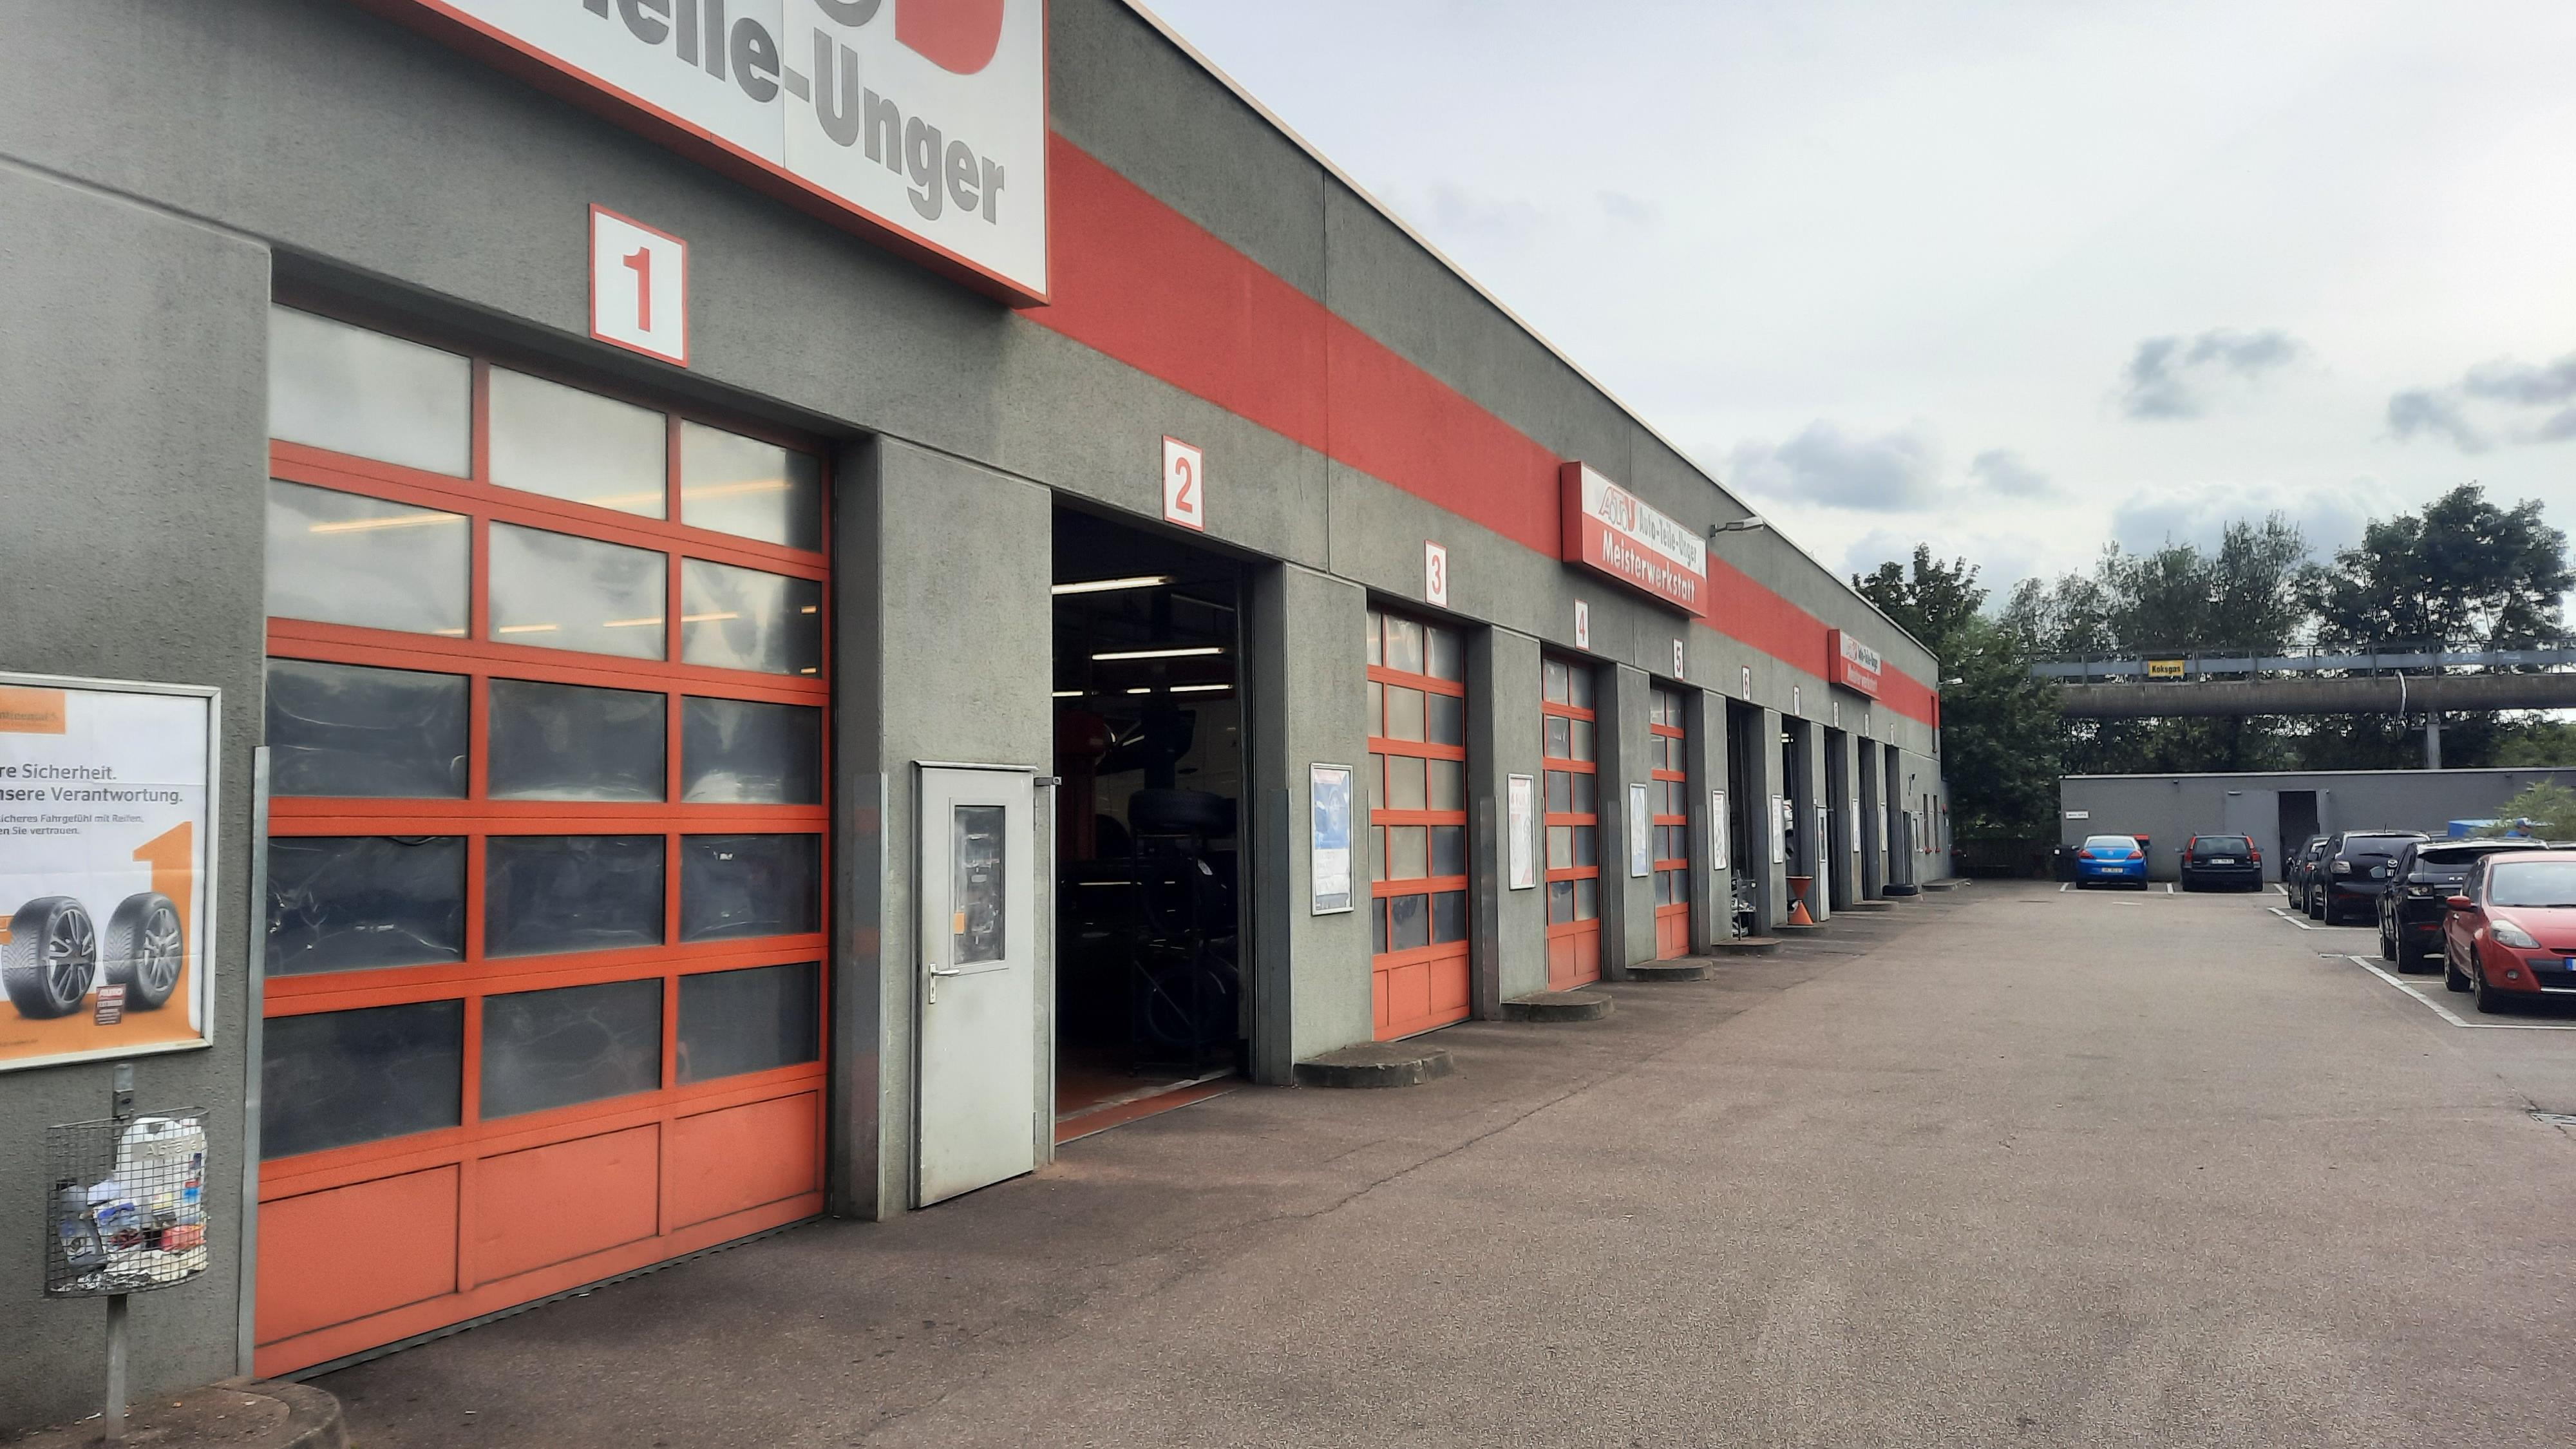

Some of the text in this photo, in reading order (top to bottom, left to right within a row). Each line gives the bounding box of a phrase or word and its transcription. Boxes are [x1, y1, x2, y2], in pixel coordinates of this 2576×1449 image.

[623, 246, 650, 332] 1
[1175, 457, 1193, 514] 2
[1639, 506, 1697, 567] Auto-Teile-Unger
[1432, 554, 1442, 595] 3
[1602, 529, 1696, 603] Meisterwerkstatt
[1579, 610, 1586, 641] 4
[1676, 646, 1681, 673] 5
[2152, 665, 2181, 674] Koksgas
[21, 763, 117, 780] Sicherheit.
[50, 786, 184, 805] Verantwortung.
[0, 813, 38, 823] icheres
[41, 813, 92, 824] Fahrgefühl
[12, 826, 27, 835] Sie
